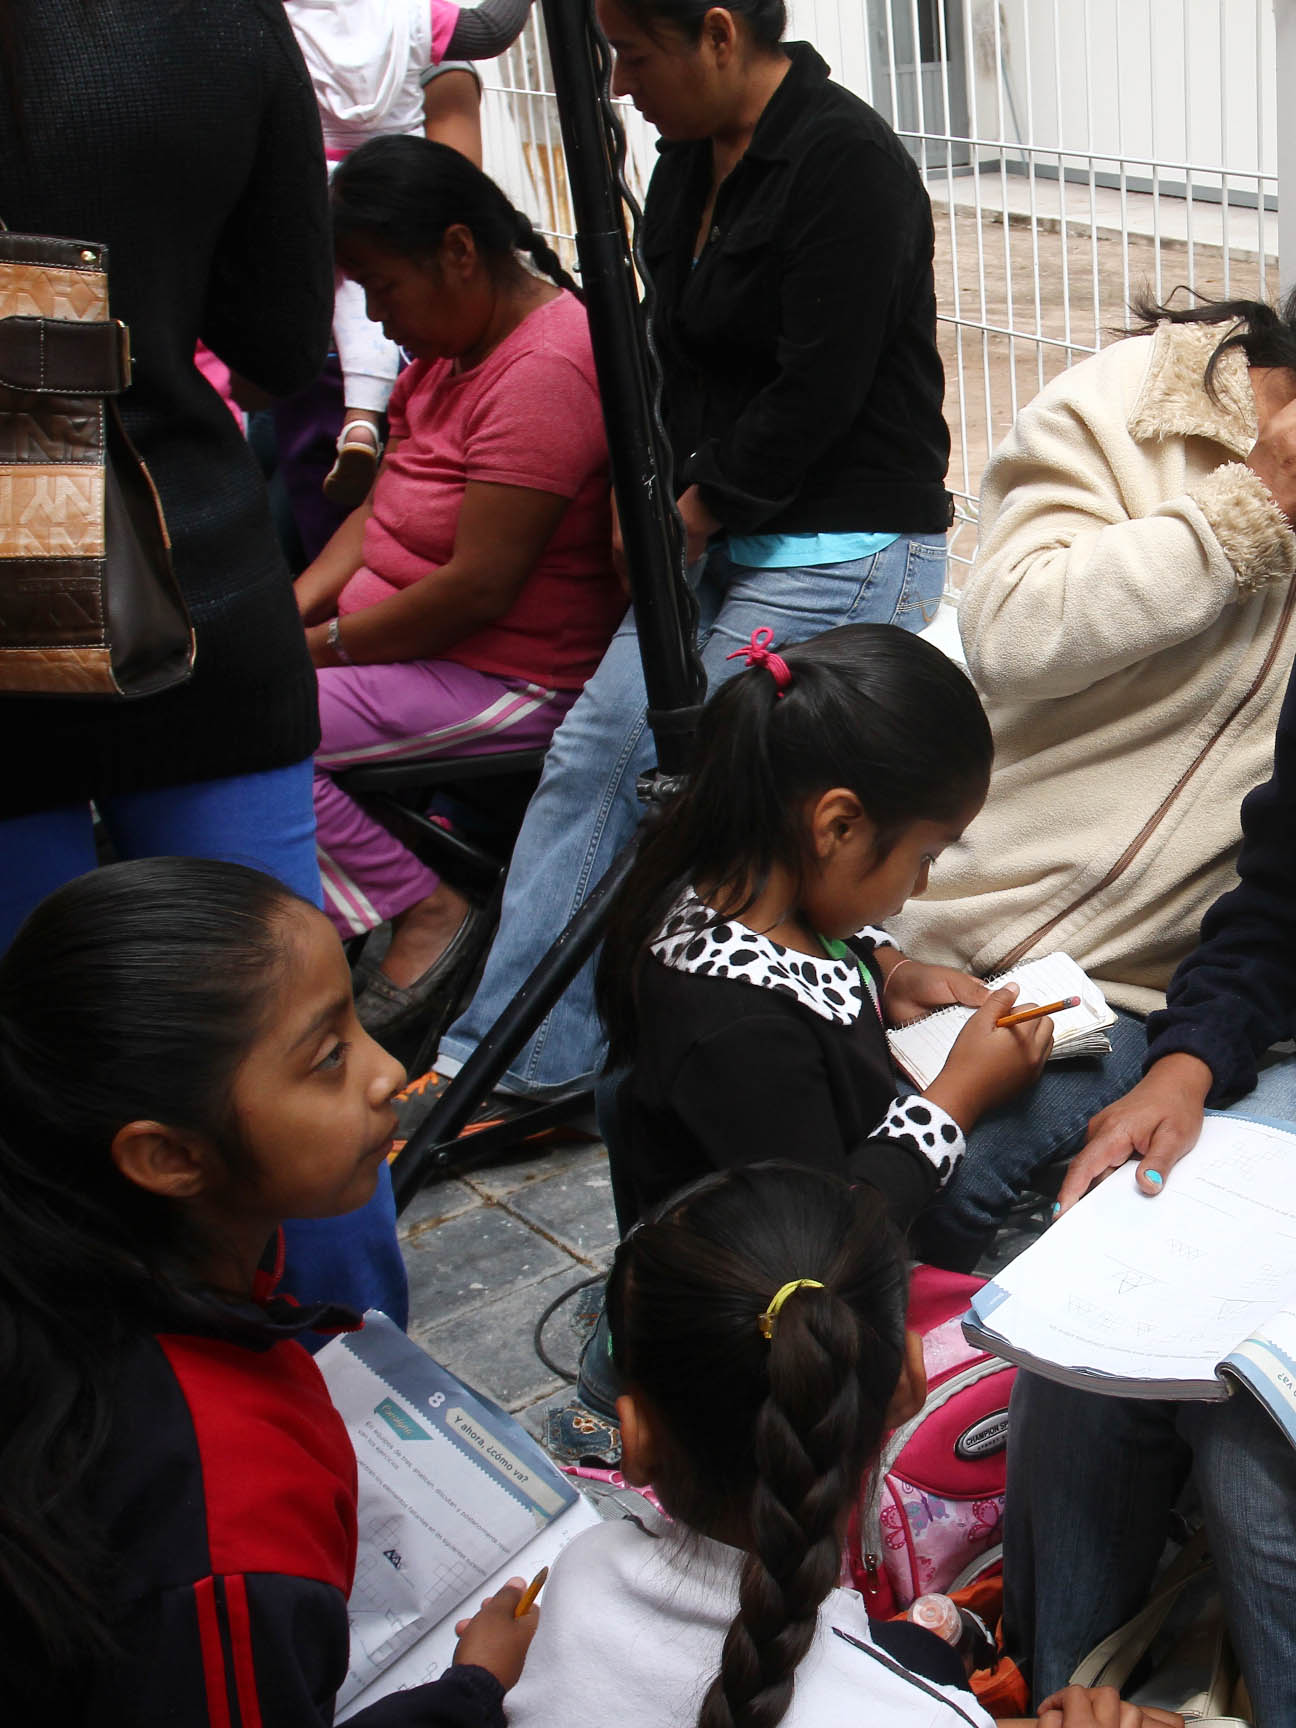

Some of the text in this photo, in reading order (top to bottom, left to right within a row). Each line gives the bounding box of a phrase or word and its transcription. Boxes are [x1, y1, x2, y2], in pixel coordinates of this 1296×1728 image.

[1277, 1373, 1293, 1390] va?
[428, 1392, 445, 1408] 8
[966, 1424, 1000, 1446] CHAMPION
[454, 1416, 529, 1483] Y ahora, ¿cómo va?
